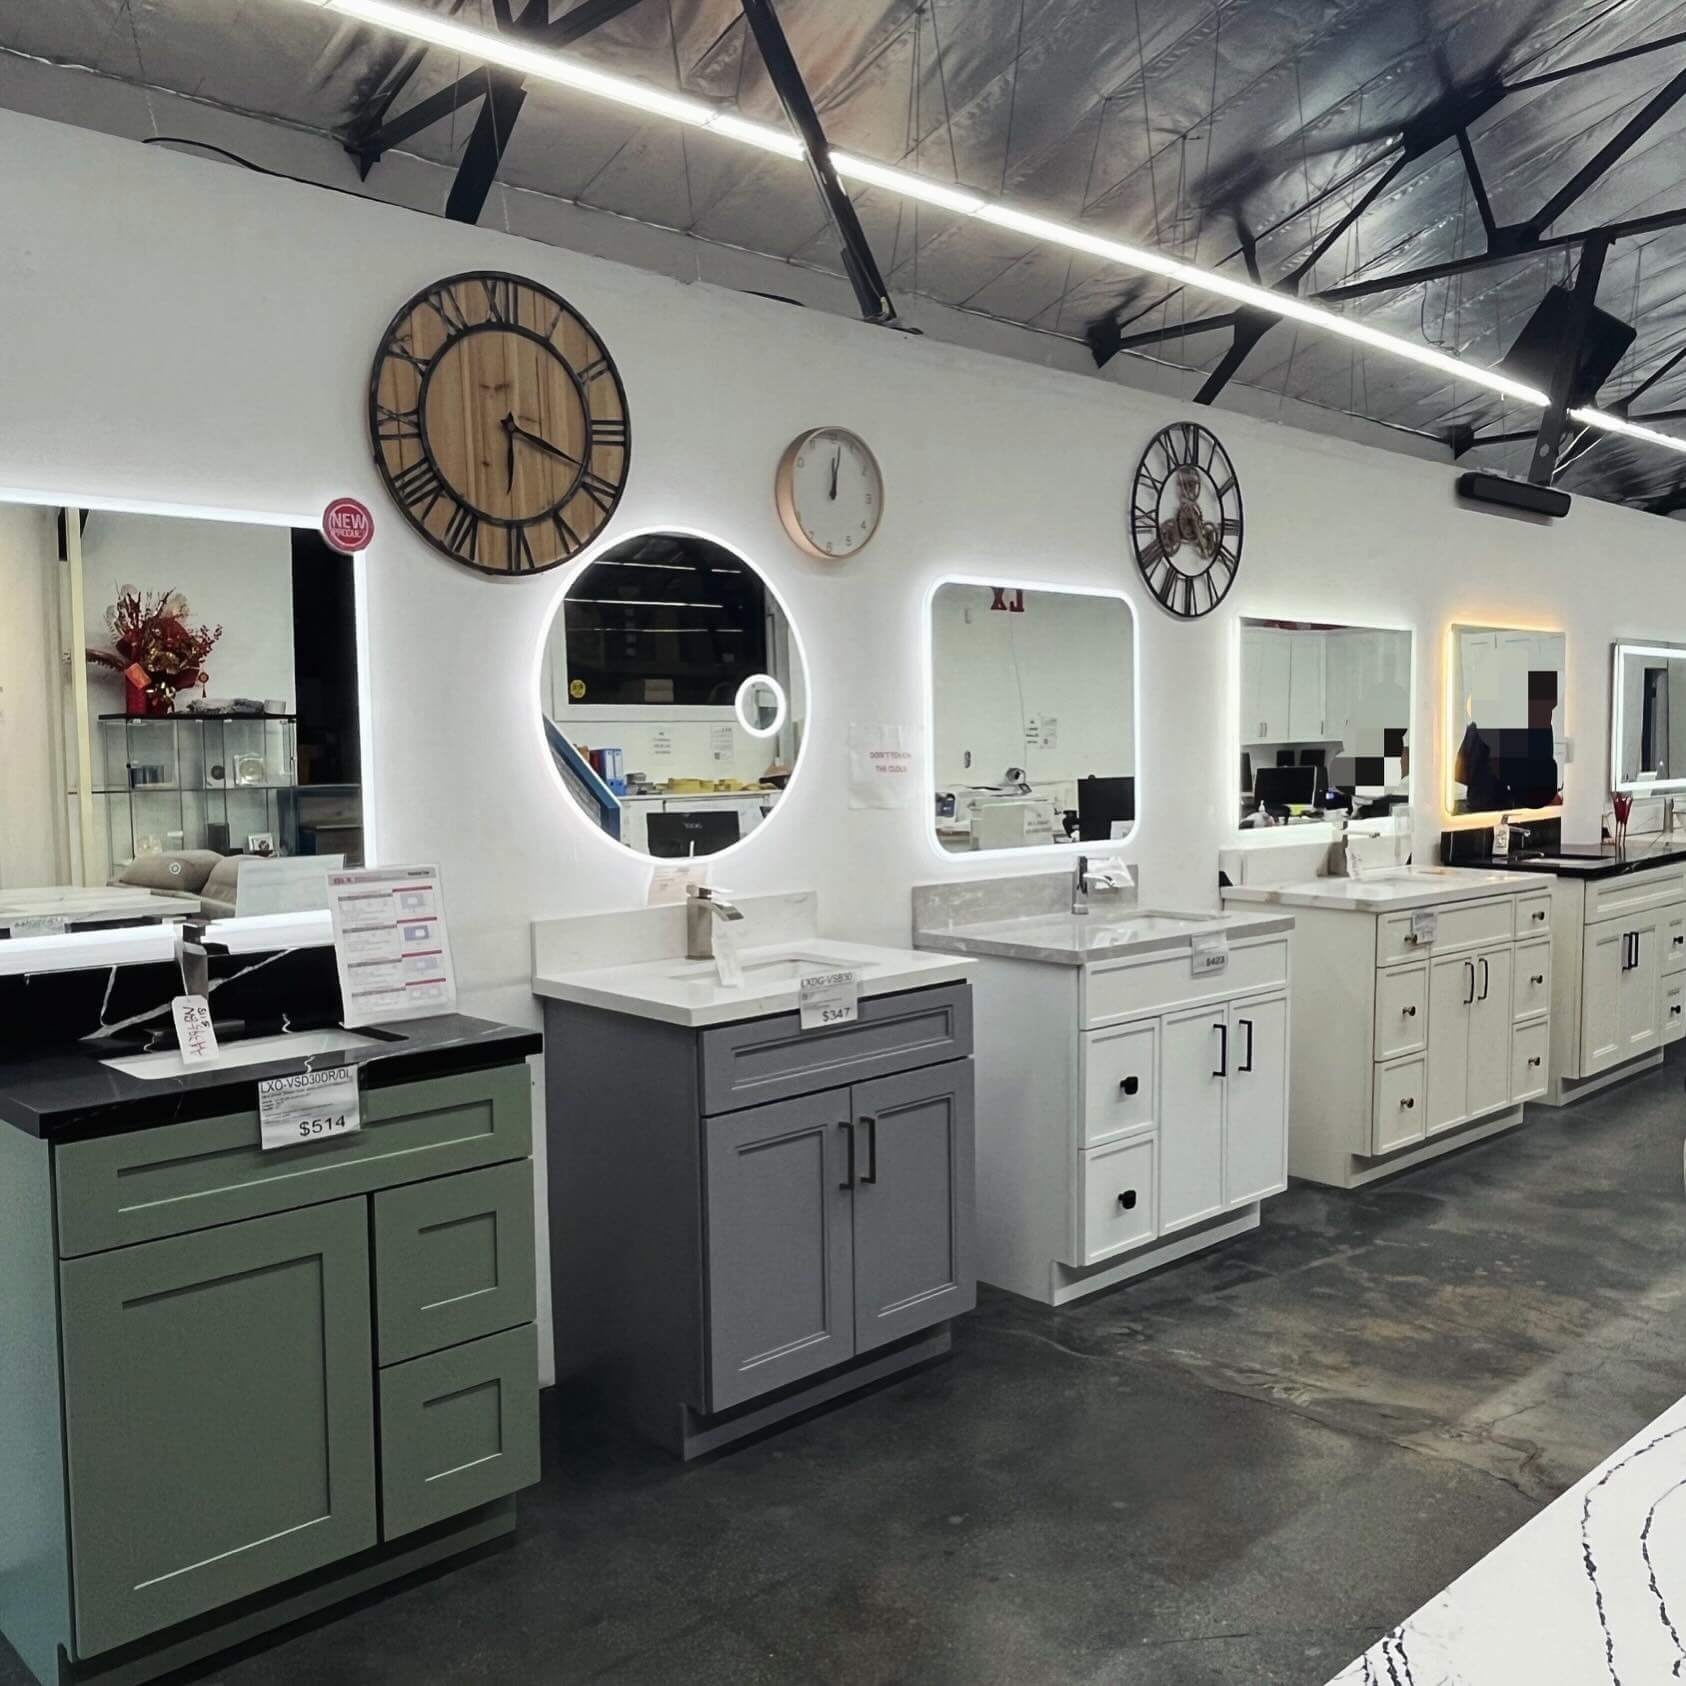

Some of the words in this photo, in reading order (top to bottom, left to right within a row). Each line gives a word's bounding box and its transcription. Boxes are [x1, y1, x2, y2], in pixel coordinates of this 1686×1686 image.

[332, 512, 366, 529] NEW
[822, 1007, 850, 1022] $347
[299, 1114, 346, 1136] $514
